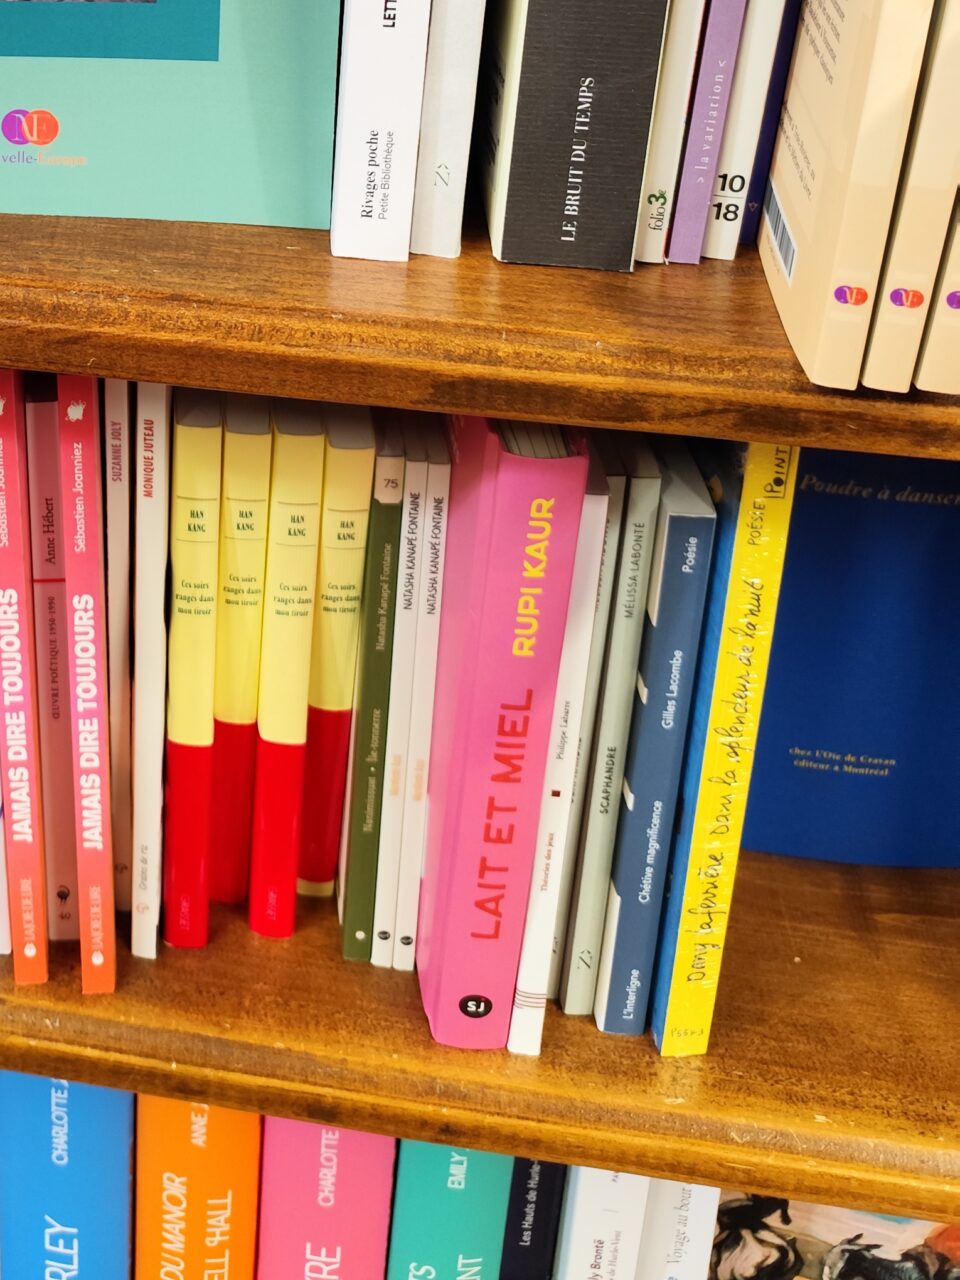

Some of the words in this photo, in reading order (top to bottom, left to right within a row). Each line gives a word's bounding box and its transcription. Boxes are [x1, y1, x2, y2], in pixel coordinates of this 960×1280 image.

[575, 76, 595, 133] TEMPS
[367, 130, 381, 166] poche
[381, 131, 395, 188] Bibliothèque
[572, 139, 586, 162] DU
[362, 168, 377, 219] Rivages
[378, 188, 389, 220] Petite
[564, 167, 581, 216] BRUIT
[718, 173, 746, 193] 10
[561, 220, 575, 242] LE
[712, 202, 739, 222] 18
[111, 421, 122, 443] JOLY
[143, 419, 154, 453] JUTEAU
[71, 442, 84, 495] Joanniez
[111, 446, 122, 483] SUZANNE
[143, 456, 153, 498] MONIQUE
[384, 478, 398, 488] 75
[41, 497, 54, 539] Hébert
[72, 496, 87, 553] Sébastien
[411, 492, 420, 533] FONTAINE
[748, 501, 766, 546] POÉSIE
[44, 541, 56, 565] Anne
[407, 533, 417, 573] KANAPÉ
[523, 497, 555, 577] KAUR
[682, 537, 697, 573] Poésie
[403, 574, 413, 611] NATASHA
[624, 574, 638, 618] MÉLISSA
[631, 521, 645, 571] LABONTÉ
[513, 586, 541, 656] RUPI
[72, 593, 98, 711] TOUJOURS
[666, 649, 682, 694] Lacombe
[6, 712, 29, 761] DIRE
[490, 688, 534, 784] MIEL
[662, 697, 675, 729] Gilles
[78, 718, 100, 768] DIRE
[600, 745, 616, 814] SCAPHANDRE
[9, 767, 33, 843] JAMAIS
[80, 773, 103, 851] JAMAIS
[484, 796, 517, 845] ET
[639, 866, 651, 904] Chétive
[645, 799, 663, 863] magnificence
[471, 856, 509, 939] LAIT
[622, 969, 639, 1020] L'Interligne
[50, 1088, 69, 1166] CHARLOTTE
[191, 1112, 209, 1147] ANNE
[318, 1129, 339, 1207] CHARLOTTE
[448, 1151, 467, 1189] EMILY
[161, 1172, 188, 1253] MANOIR
[205, 1190, 232, 1246] HALL
[160, 1253, 185, 1280] DU
[591, 1239, 604, 1270] Brontë
